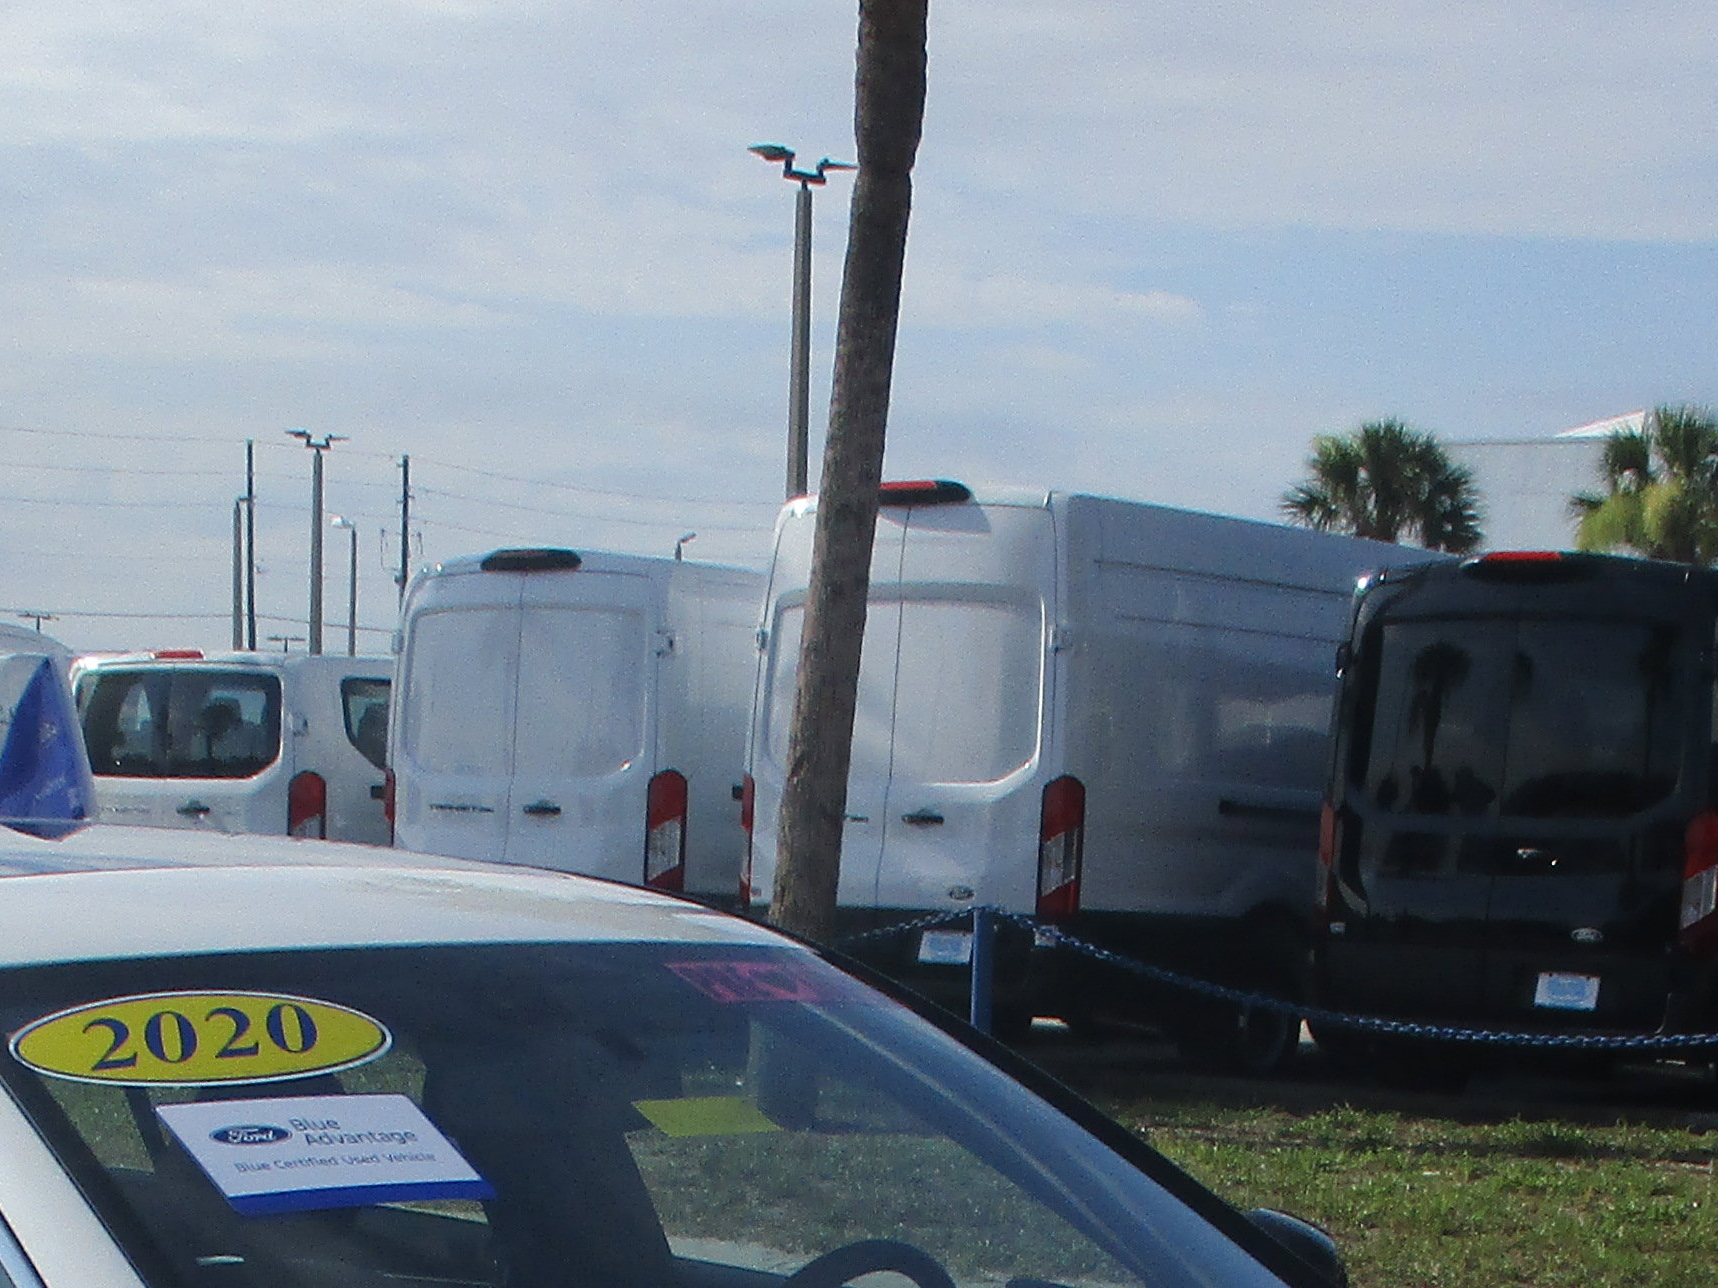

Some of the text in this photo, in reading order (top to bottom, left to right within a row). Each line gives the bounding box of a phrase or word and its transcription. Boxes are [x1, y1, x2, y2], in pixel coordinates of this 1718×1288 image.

[82, 1003, 319, 1071] 2020
[289, 1118, 341, 1131] Blue
[227, 1127, 276, 1144] Ford
[305, 1130, 418, 1146] Advantage
[233, 1161, 271, 1173] Blue
[274, 1155, 339, 1170] Certified
[342, 1153, 381, 1165] Used
